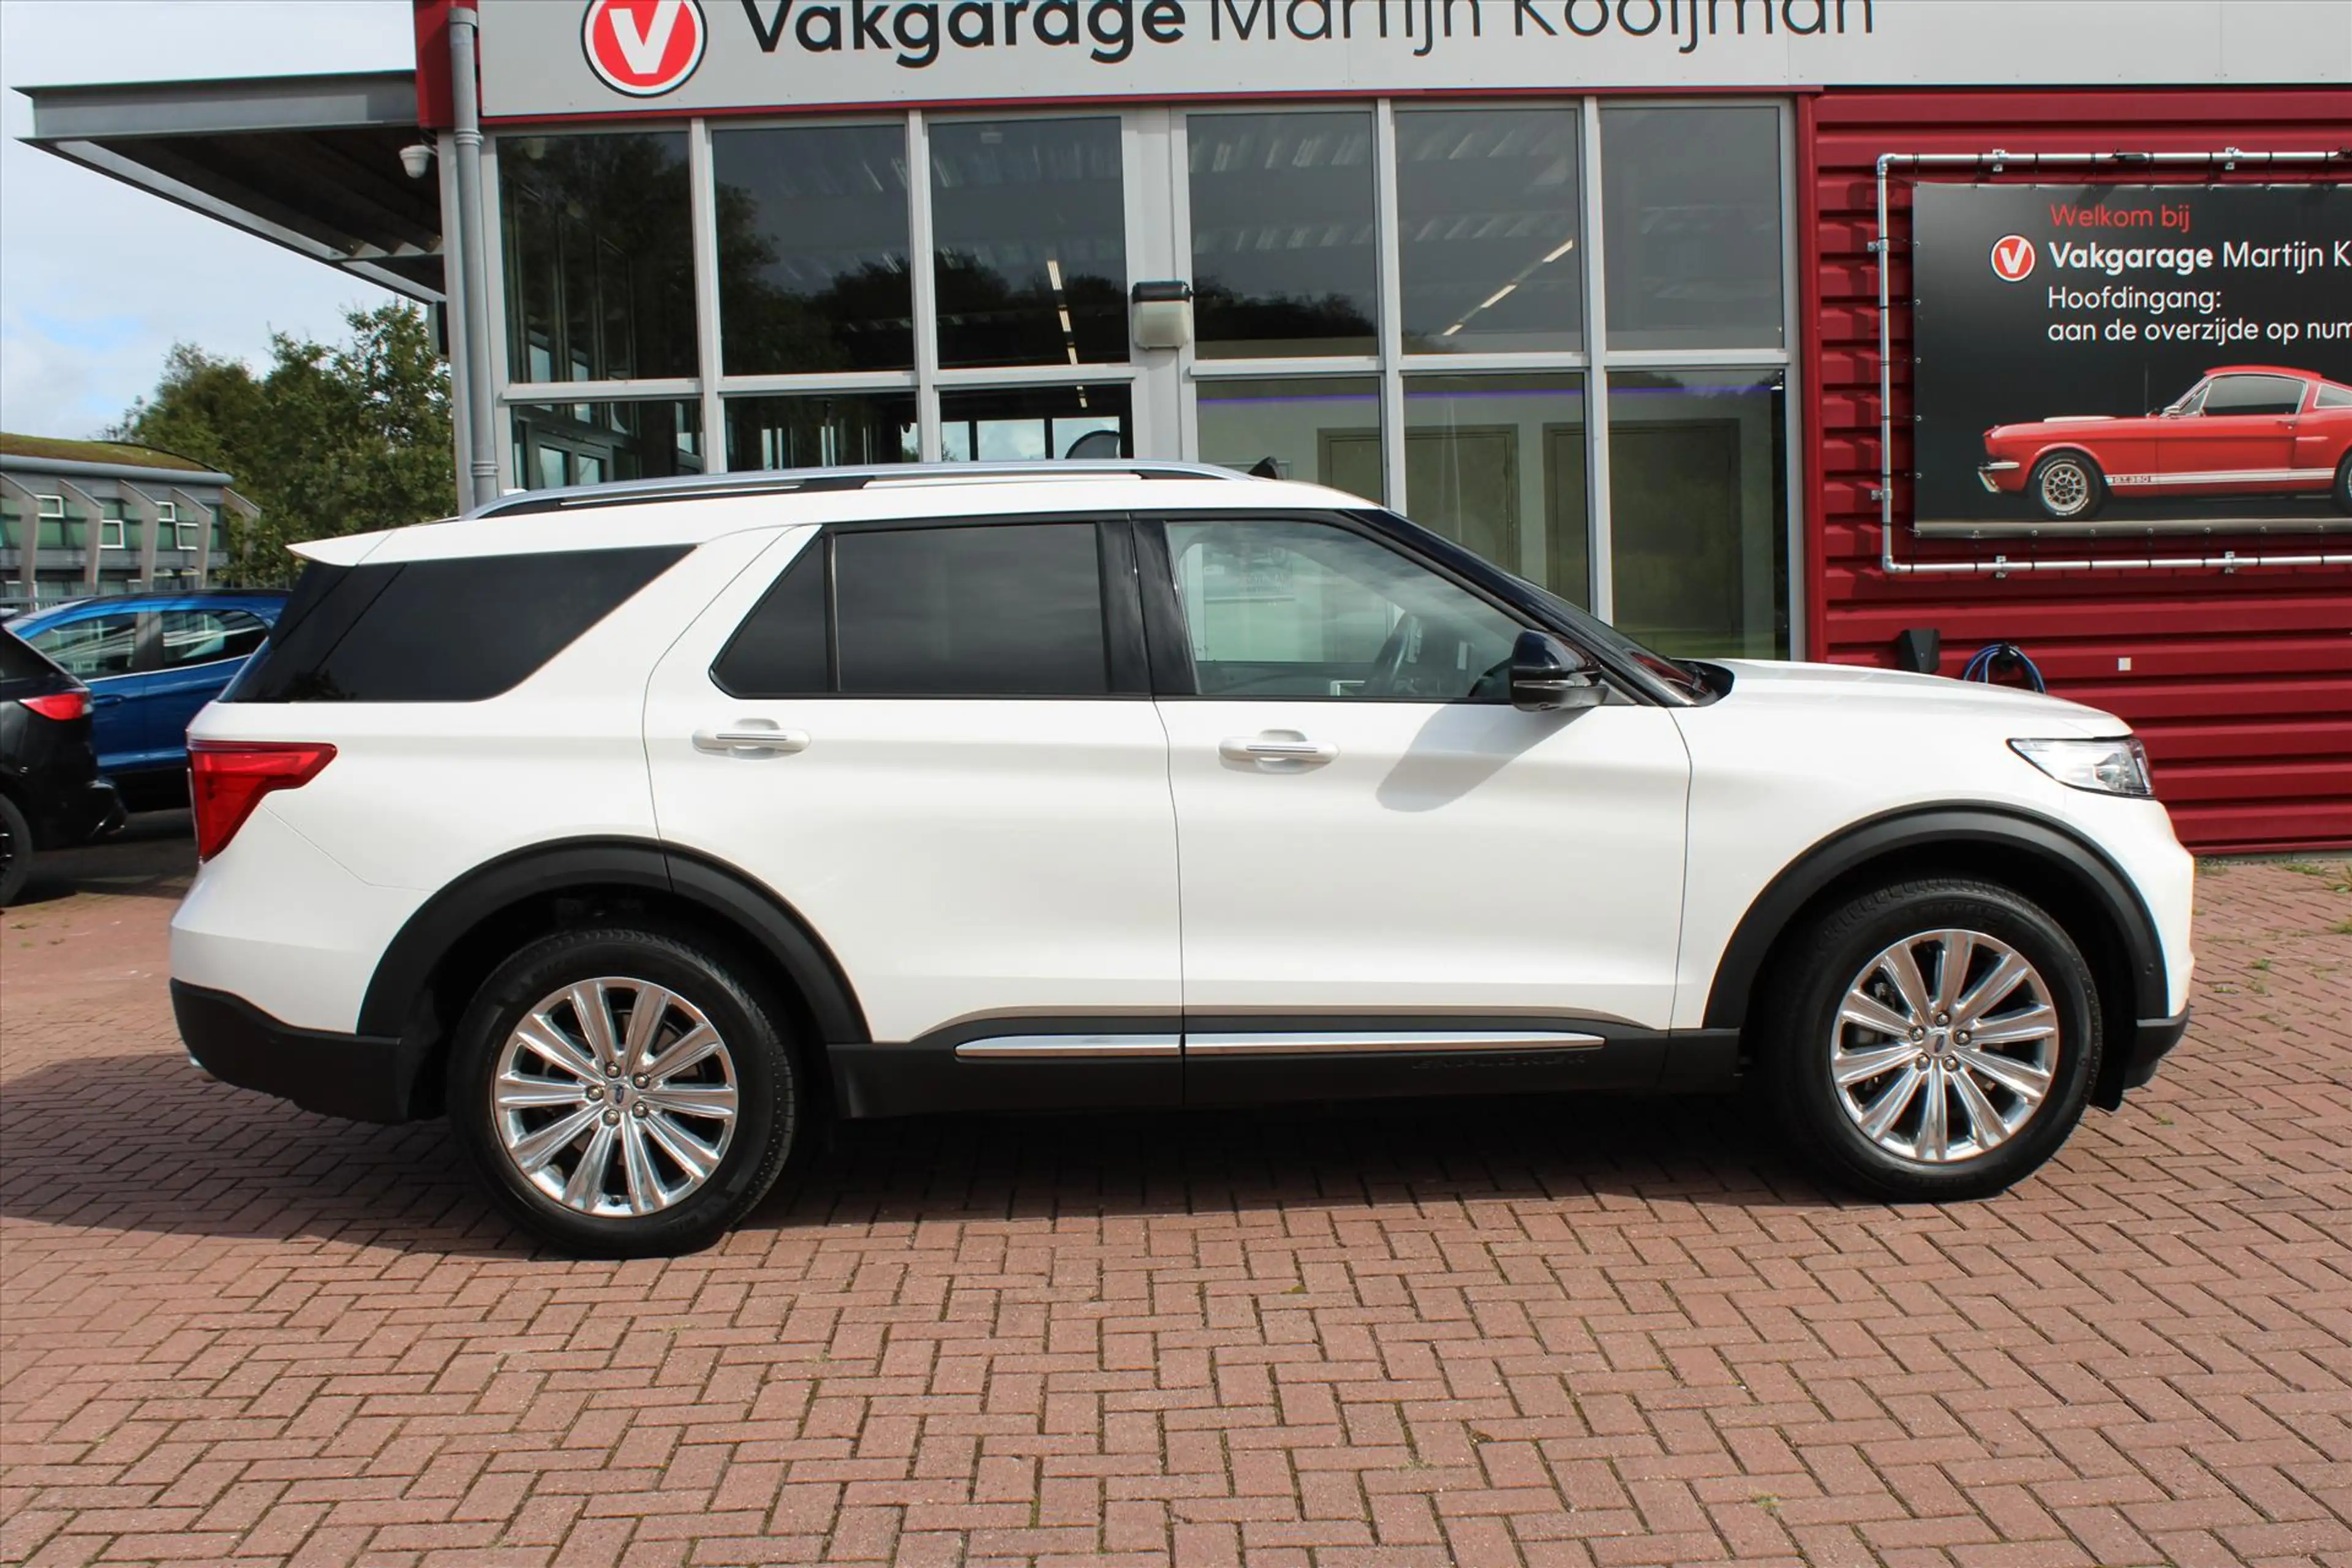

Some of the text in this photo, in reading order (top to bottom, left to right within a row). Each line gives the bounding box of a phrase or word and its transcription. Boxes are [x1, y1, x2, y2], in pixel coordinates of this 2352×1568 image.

[741, 0, 1186, 68] Vakgarage
[2050, 205, 2190, 233] Welkom bij
[2048, 242, 2214, 276] Vakgarage
[2223, 241, 2323, 274] Martijn
[2048, 286, 2222, 315] Hoofdingang:
[2048, 324, 2096, 341] aan
[2105, 318, 2137, 341] de
[2144, 317, 2259, 346] overzijde
[2266, 323, 2299, 345] op
